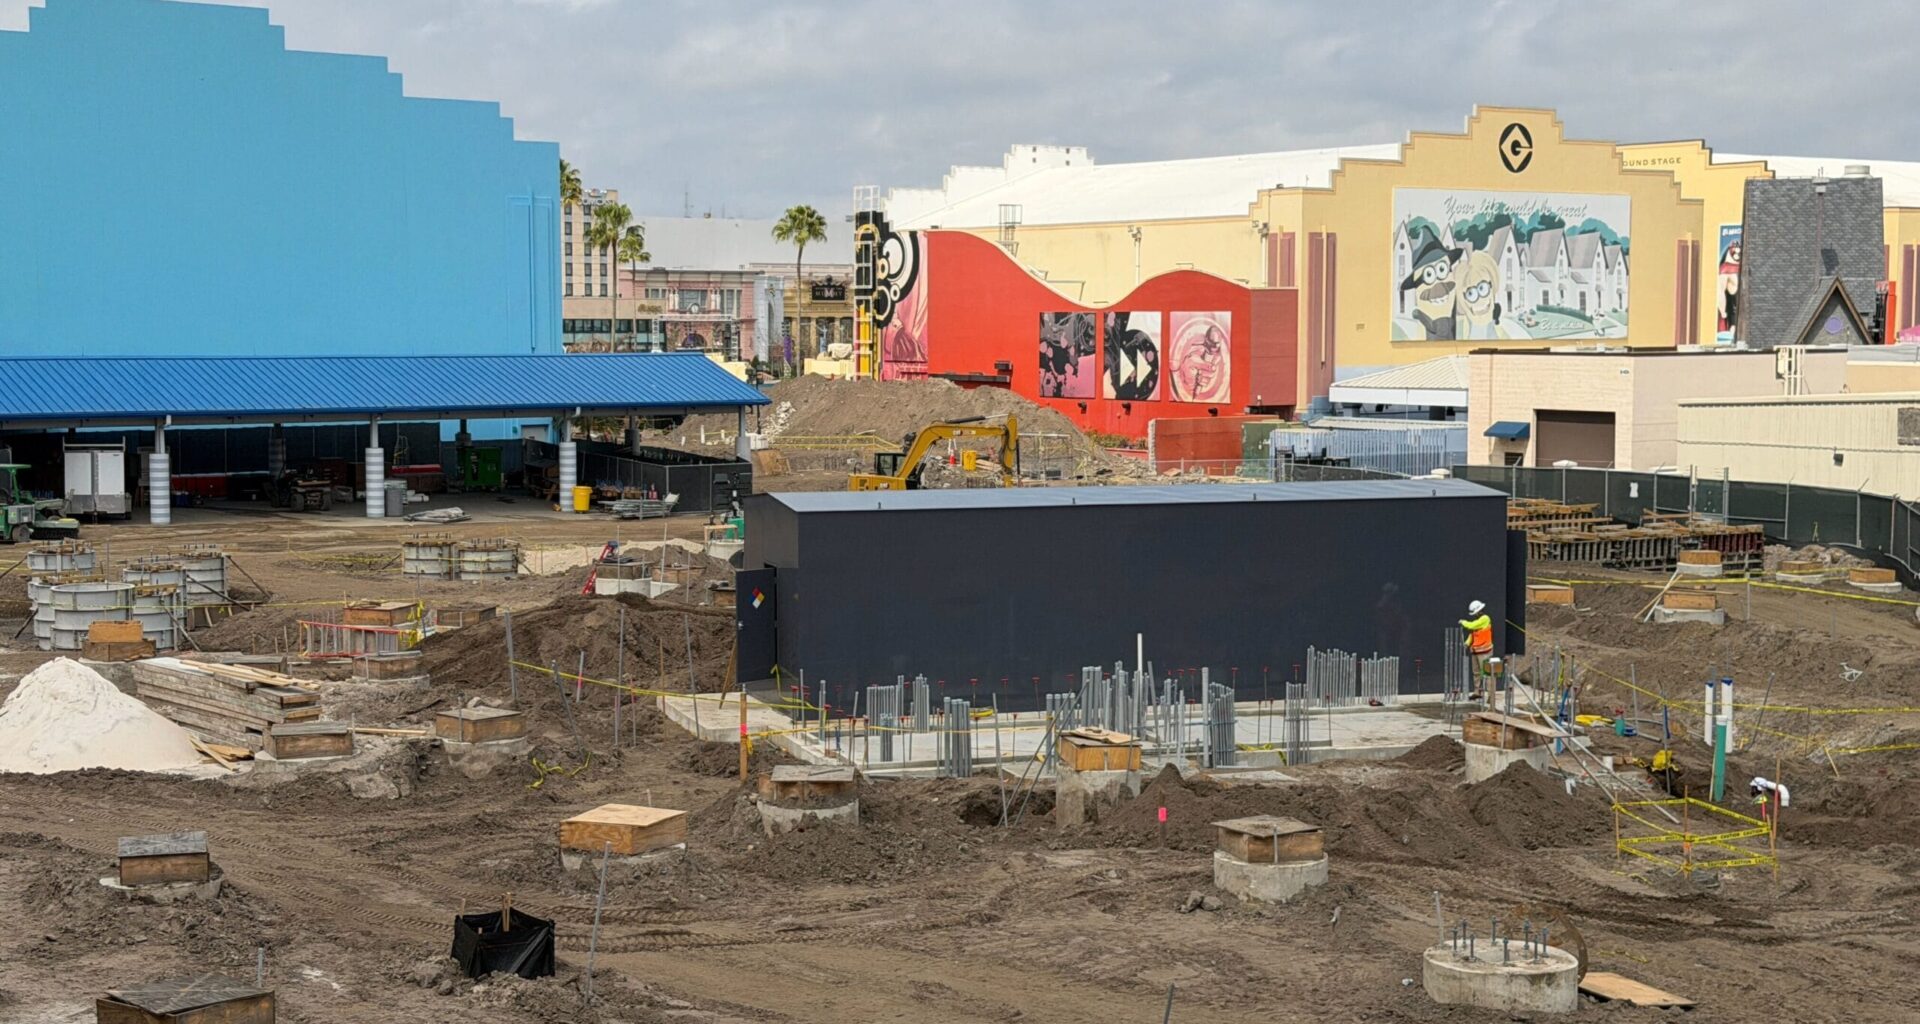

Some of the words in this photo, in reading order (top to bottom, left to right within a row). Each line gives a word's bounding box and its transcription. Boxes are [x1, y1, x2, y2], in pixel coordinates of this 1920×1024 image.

[1651, 157, 1682, 166] STAGE
[1444, 195, 1476, 221] Your
[1479, 197, 1500, 221] life
[1503, 199, 1538, 216] could
[1540, 197, 1552, 216] be
[1554, 203, 1588, 222] great
